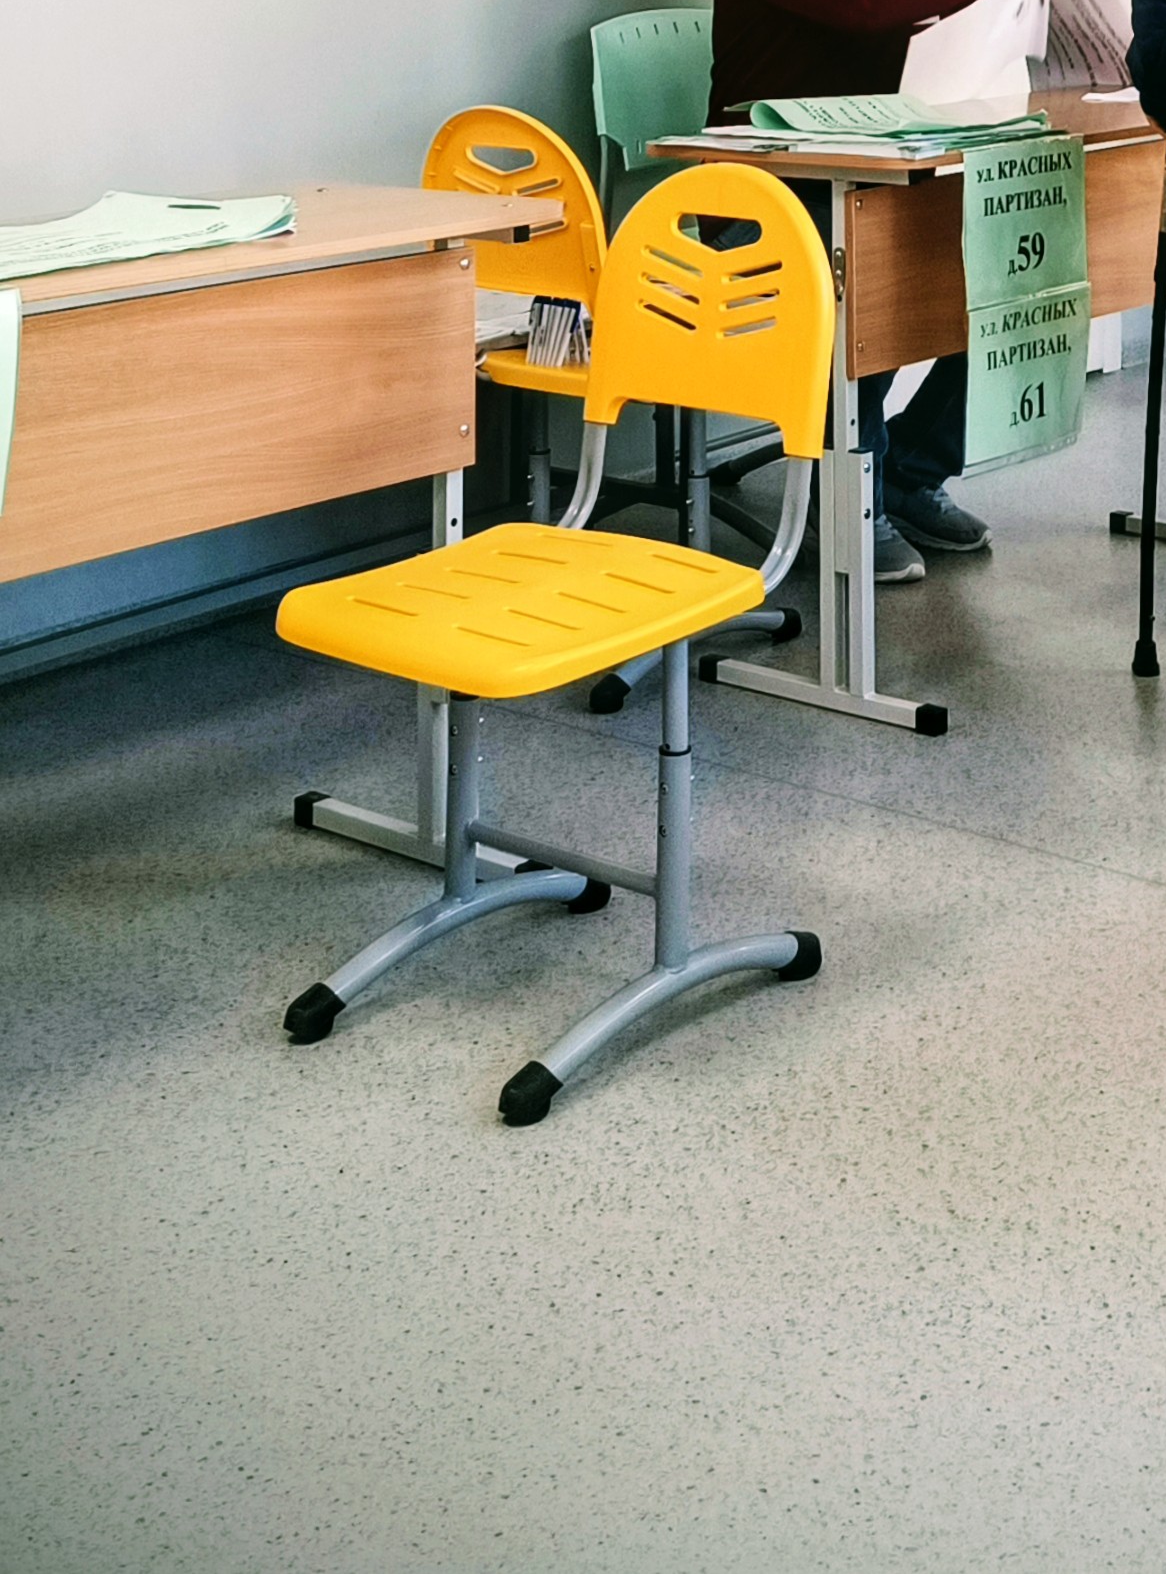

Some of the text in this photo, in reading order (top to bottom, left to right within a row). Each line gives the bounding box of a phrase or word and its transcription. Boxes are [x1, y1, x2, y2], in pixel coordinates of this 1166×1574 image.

[997, 151, 1073, 179] КРАСНЫХ
[983, 184, 1068, 217] ПАРТИЗАН,
[1002, 298, 1078, 332] КРАСНЫХ
[986, 333, 1072, 371] ПАРТИЗАН,
